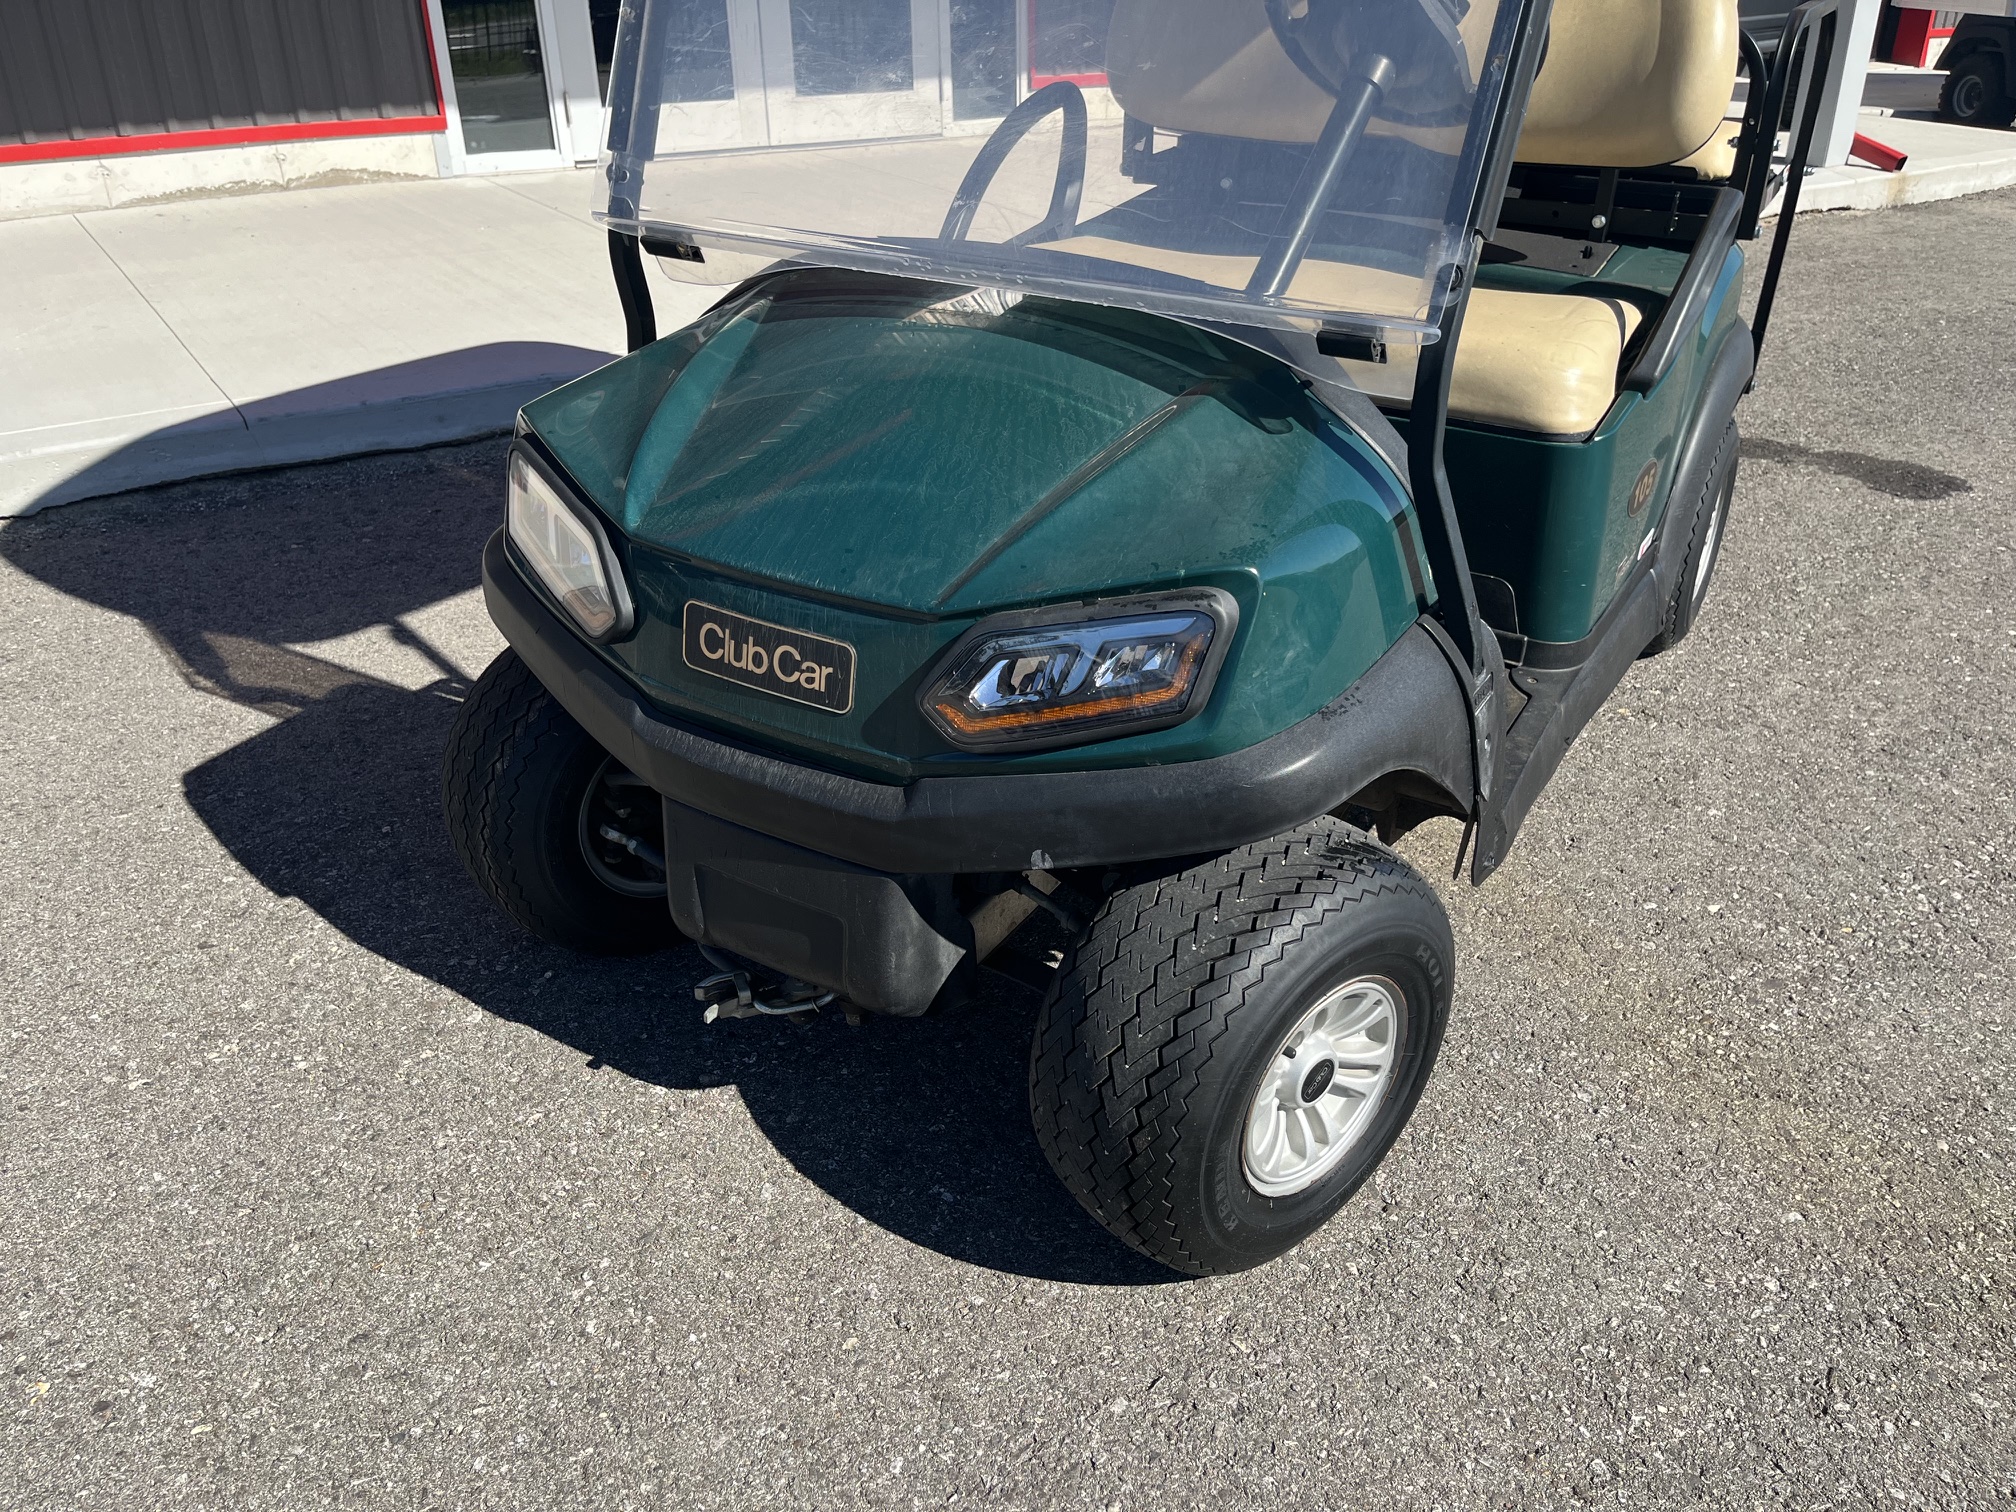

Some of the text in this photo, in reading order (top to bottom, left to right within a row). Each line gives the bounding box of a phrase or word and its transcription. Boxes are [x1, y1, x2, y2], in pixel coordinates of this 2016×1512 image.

[1634, 467, 1655, 509] 105
[700, 622, 833, 692] Club Car
